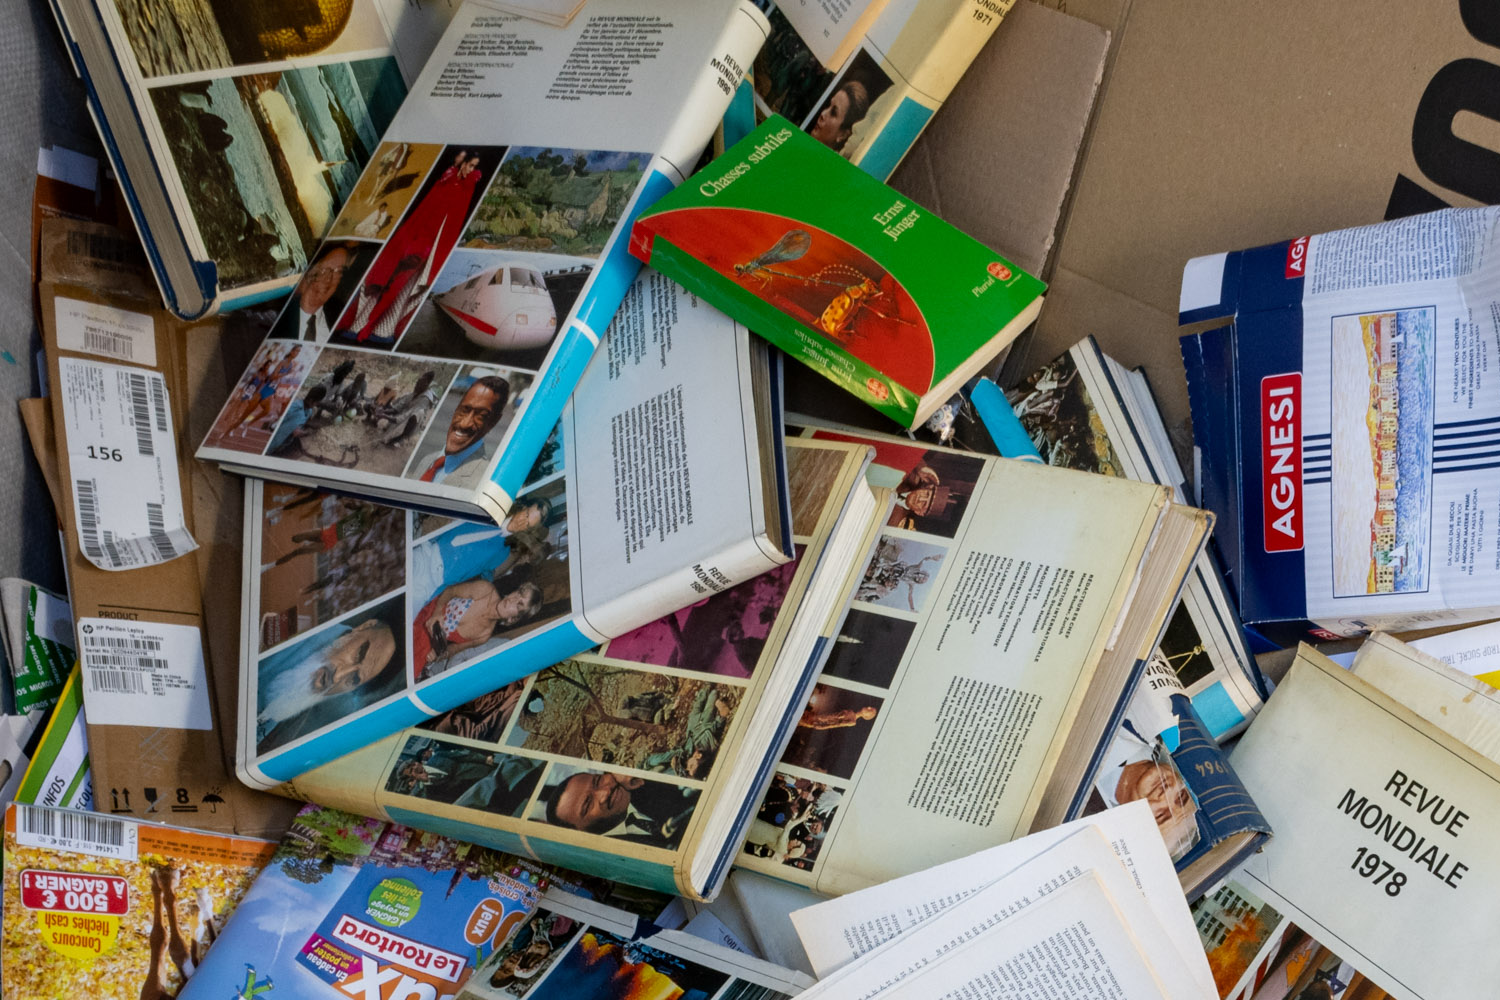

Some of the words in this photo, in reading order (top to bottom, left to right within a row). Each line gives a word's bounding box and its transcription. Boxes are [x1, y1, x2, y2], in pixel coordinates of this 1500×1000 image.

[970, 8, 993, 26] 1971
[722, 53, 745, 79] REVUE
[714, 76, 732, 95] 1990
[699, 160, 750, 198] Chasses
[747, 127, 793, 164] subtiles
[872, 199, 906, 225] Ernst
[882, 209, 920, 241] Jünger
[1466, 348, 1476, 387] INGREDIENTS
[86, 445, 123, 462] 156
[1269, 385, 1295, 537] AGNESI
[690, 561, 725, 596] MONDIALE
[707, 563, 732, 588] REVUE
[986, 557, 1013, 615] COLLABORATEURS
[1008, 561, 1031, 610] COORDINATION
[1032, 565, 1049, 600] MAQUETTE
[992, 610, 1010, 647] TECHNIQUE
[1481, 643, 1499, 655] TROP
[1195, 760, 1228, 776] 1964
[175, 787, 190, 804] 8
[1384, 769, 1470, 838] REVUE
[1337, 788, 1469, 889] MONDIALE
[23, 874, 30, 887] !
[34, 874, 108, 893] GAGNER
[1351, 847, 1407, 897] 1978
[41, 889, 57, 907] €
[63, 891, 108, 911] 500
[111, 881, 124, 898] À
[378, 876, 423, 901] Eoliennes
[364, 905, 399, 924] GAGNER
[370, 896, 400, 915] voyage
[44, 913, 68, 929] cash
[71, 917, 109, 935] fléchés
[470, 902, 499, 940] jeux
[52, 932, 100, 952] Concours
[313, 944, 341, 965] poster
[337, 918, 433, 968] Routard
[305, 950, 336, 975] cadeau
[430, 952, 459, 977] Le
[1092, 947, 1106, 966] mais
[335, 969, 348, 982] En
